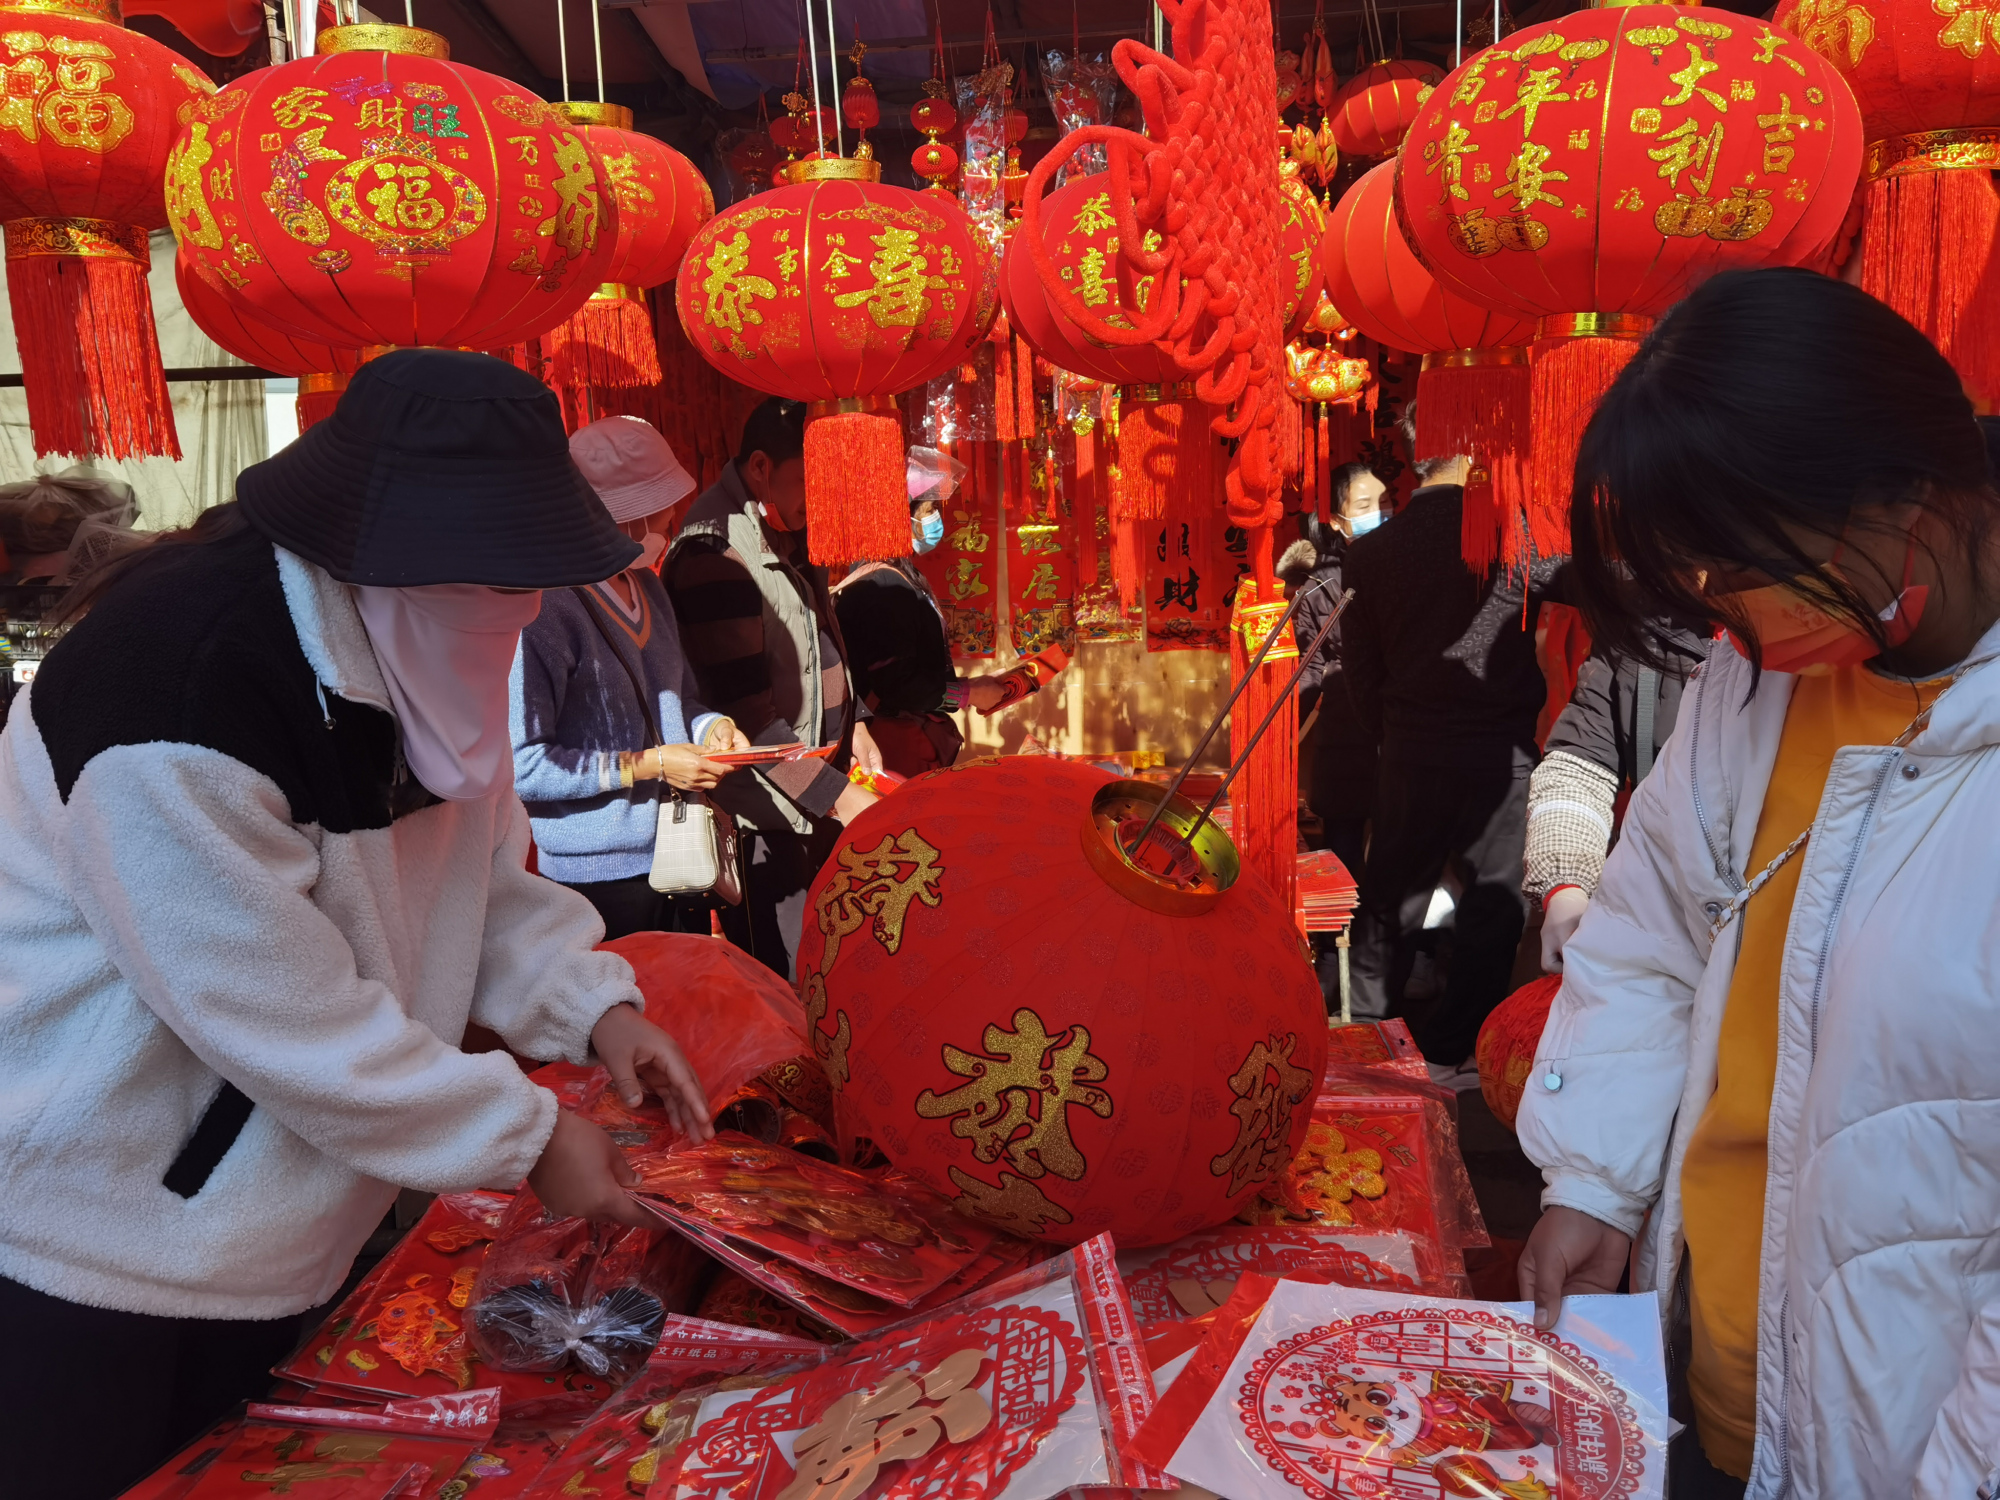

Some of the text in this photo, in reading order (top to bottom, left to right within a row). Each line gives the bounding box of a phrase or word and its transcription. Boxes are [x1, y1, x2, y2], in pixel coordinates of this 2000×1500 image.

[0, 31, 134, 153] 福
[366, 162, 445, 229] 福
[774, 246, 799, 281] 事
[821, 248, 862, 279] 金
[833, 226, 950, 328] 喜
[702, 231, 778, 334] 恭
[654, 1346, 718, 1360] 文轩纸品
[1371, 1336, 1389, 1348] 福
[1574, 1394, 1609, 1483] 新年快乐
[1566, 1445, 1576, 1472] HAPPY
[1355, 1478, 1376, 1493] 春
